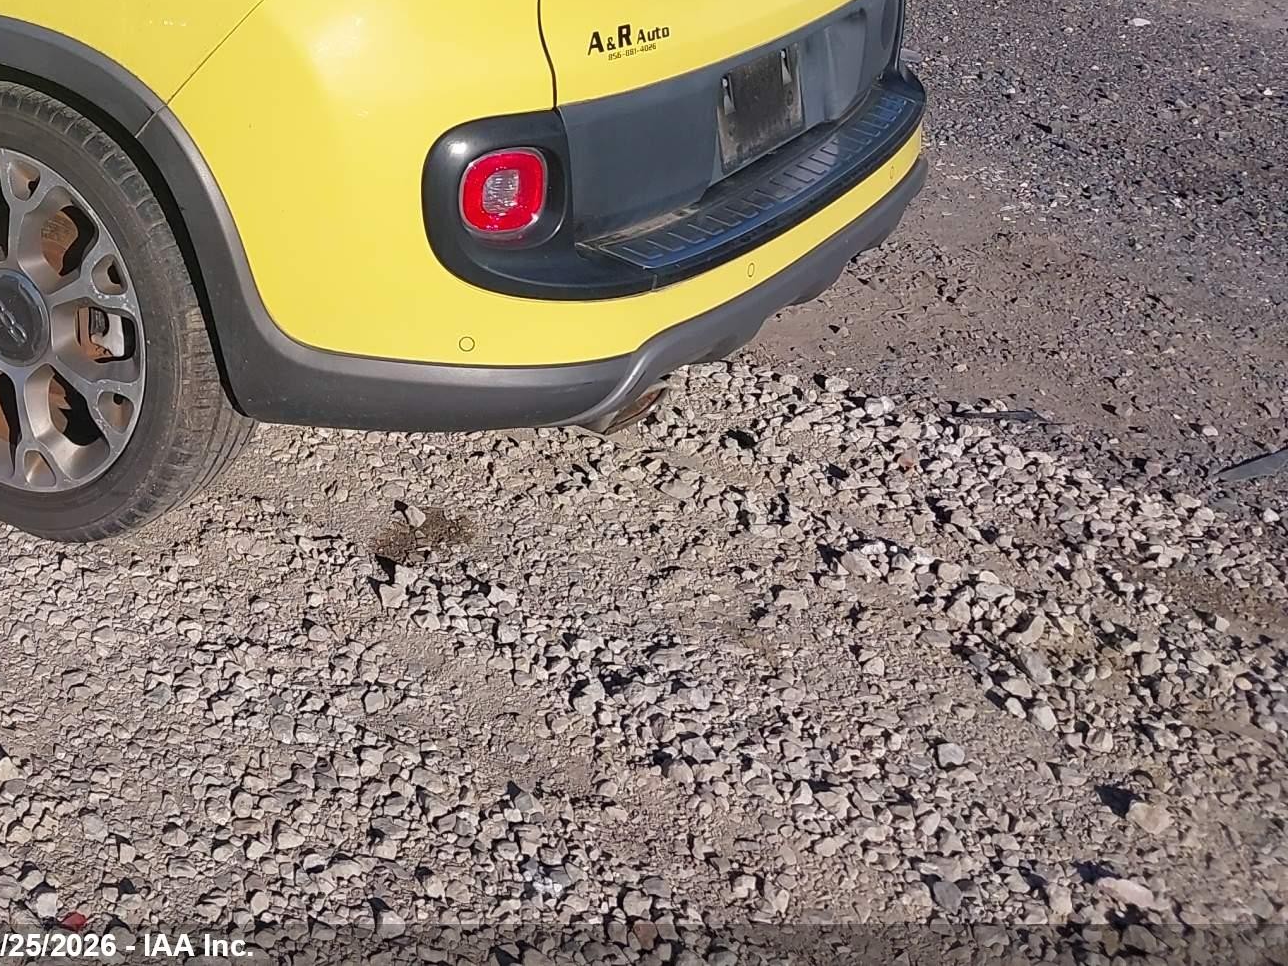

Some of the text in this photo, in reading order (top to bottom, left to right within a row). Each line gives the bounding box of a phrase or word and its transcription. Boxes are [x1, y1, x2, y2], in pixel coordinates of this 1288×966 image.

[588, 24, 669, 55] A & R Auto
